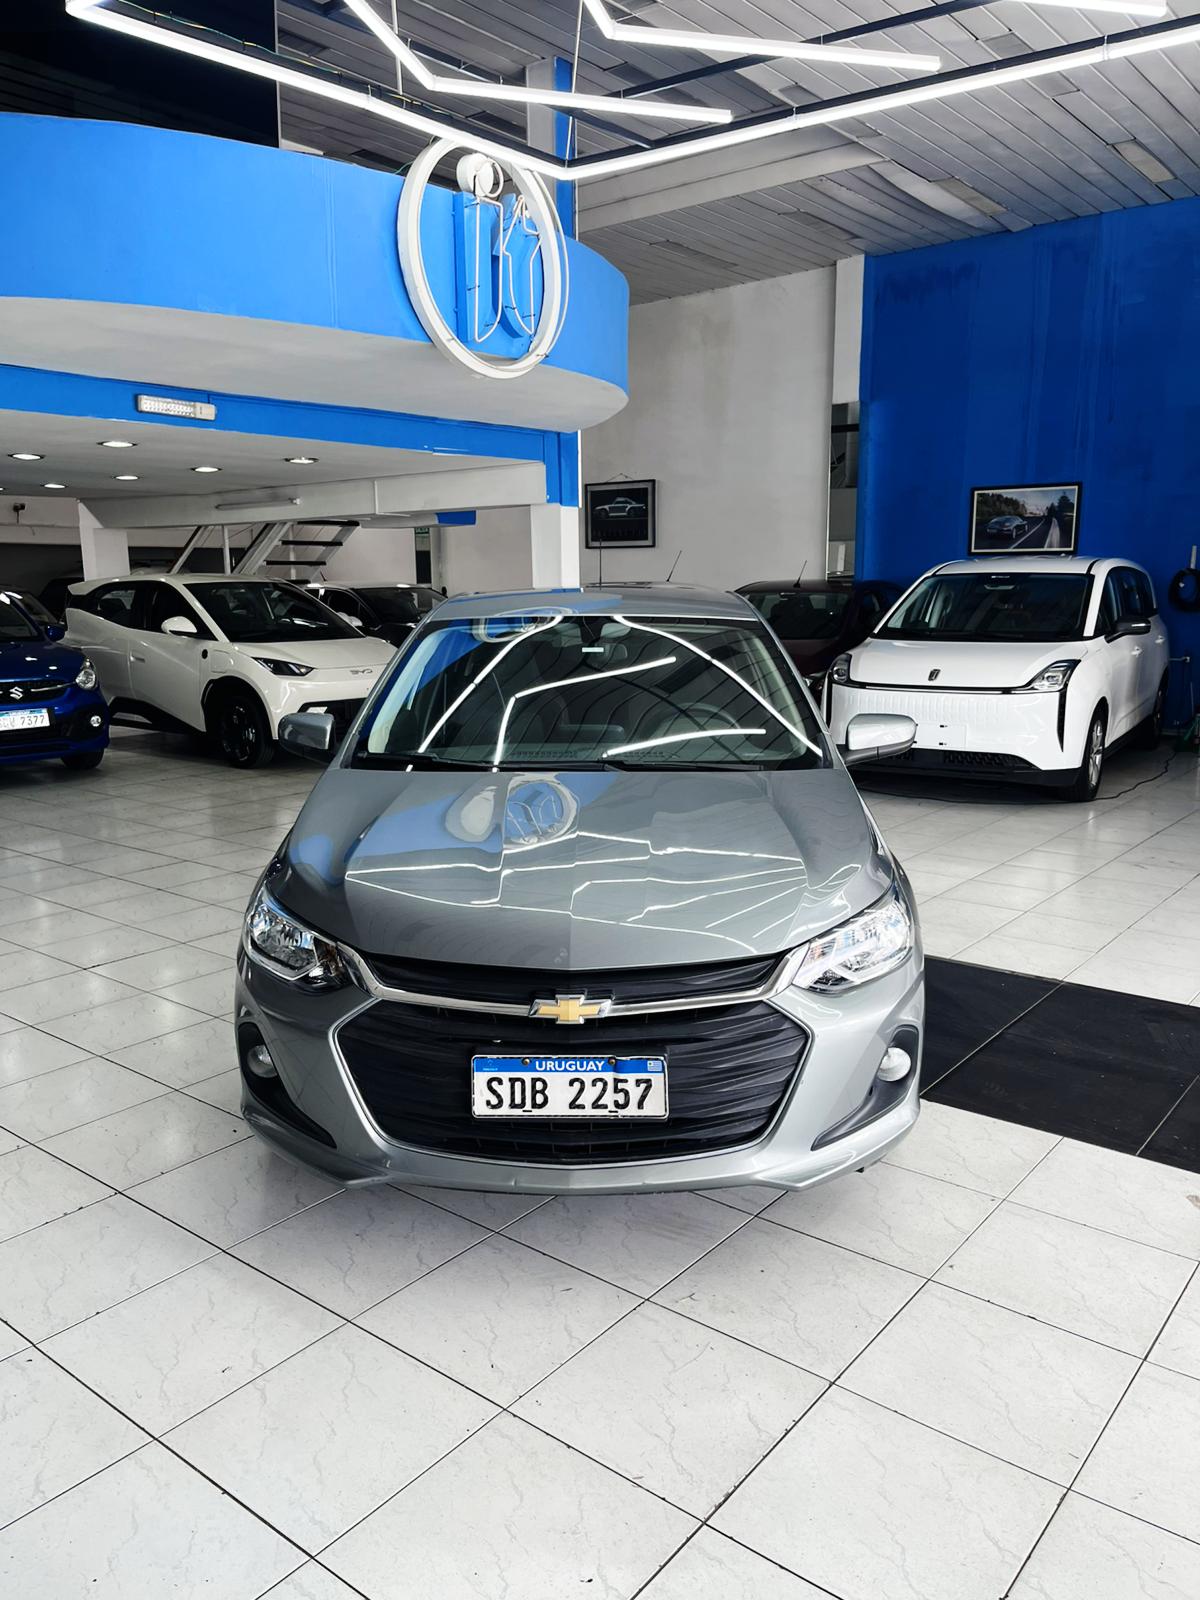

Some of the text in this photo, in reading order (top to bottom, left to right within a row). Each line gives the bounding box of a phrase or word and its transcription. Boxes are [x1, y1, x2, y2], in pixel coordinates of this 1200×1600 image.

[20, 714, 45, 726] 7377
[535, 1060, 605, 1071] URUGUAY
[485, 1076, 653, 1110] SDB 2257
